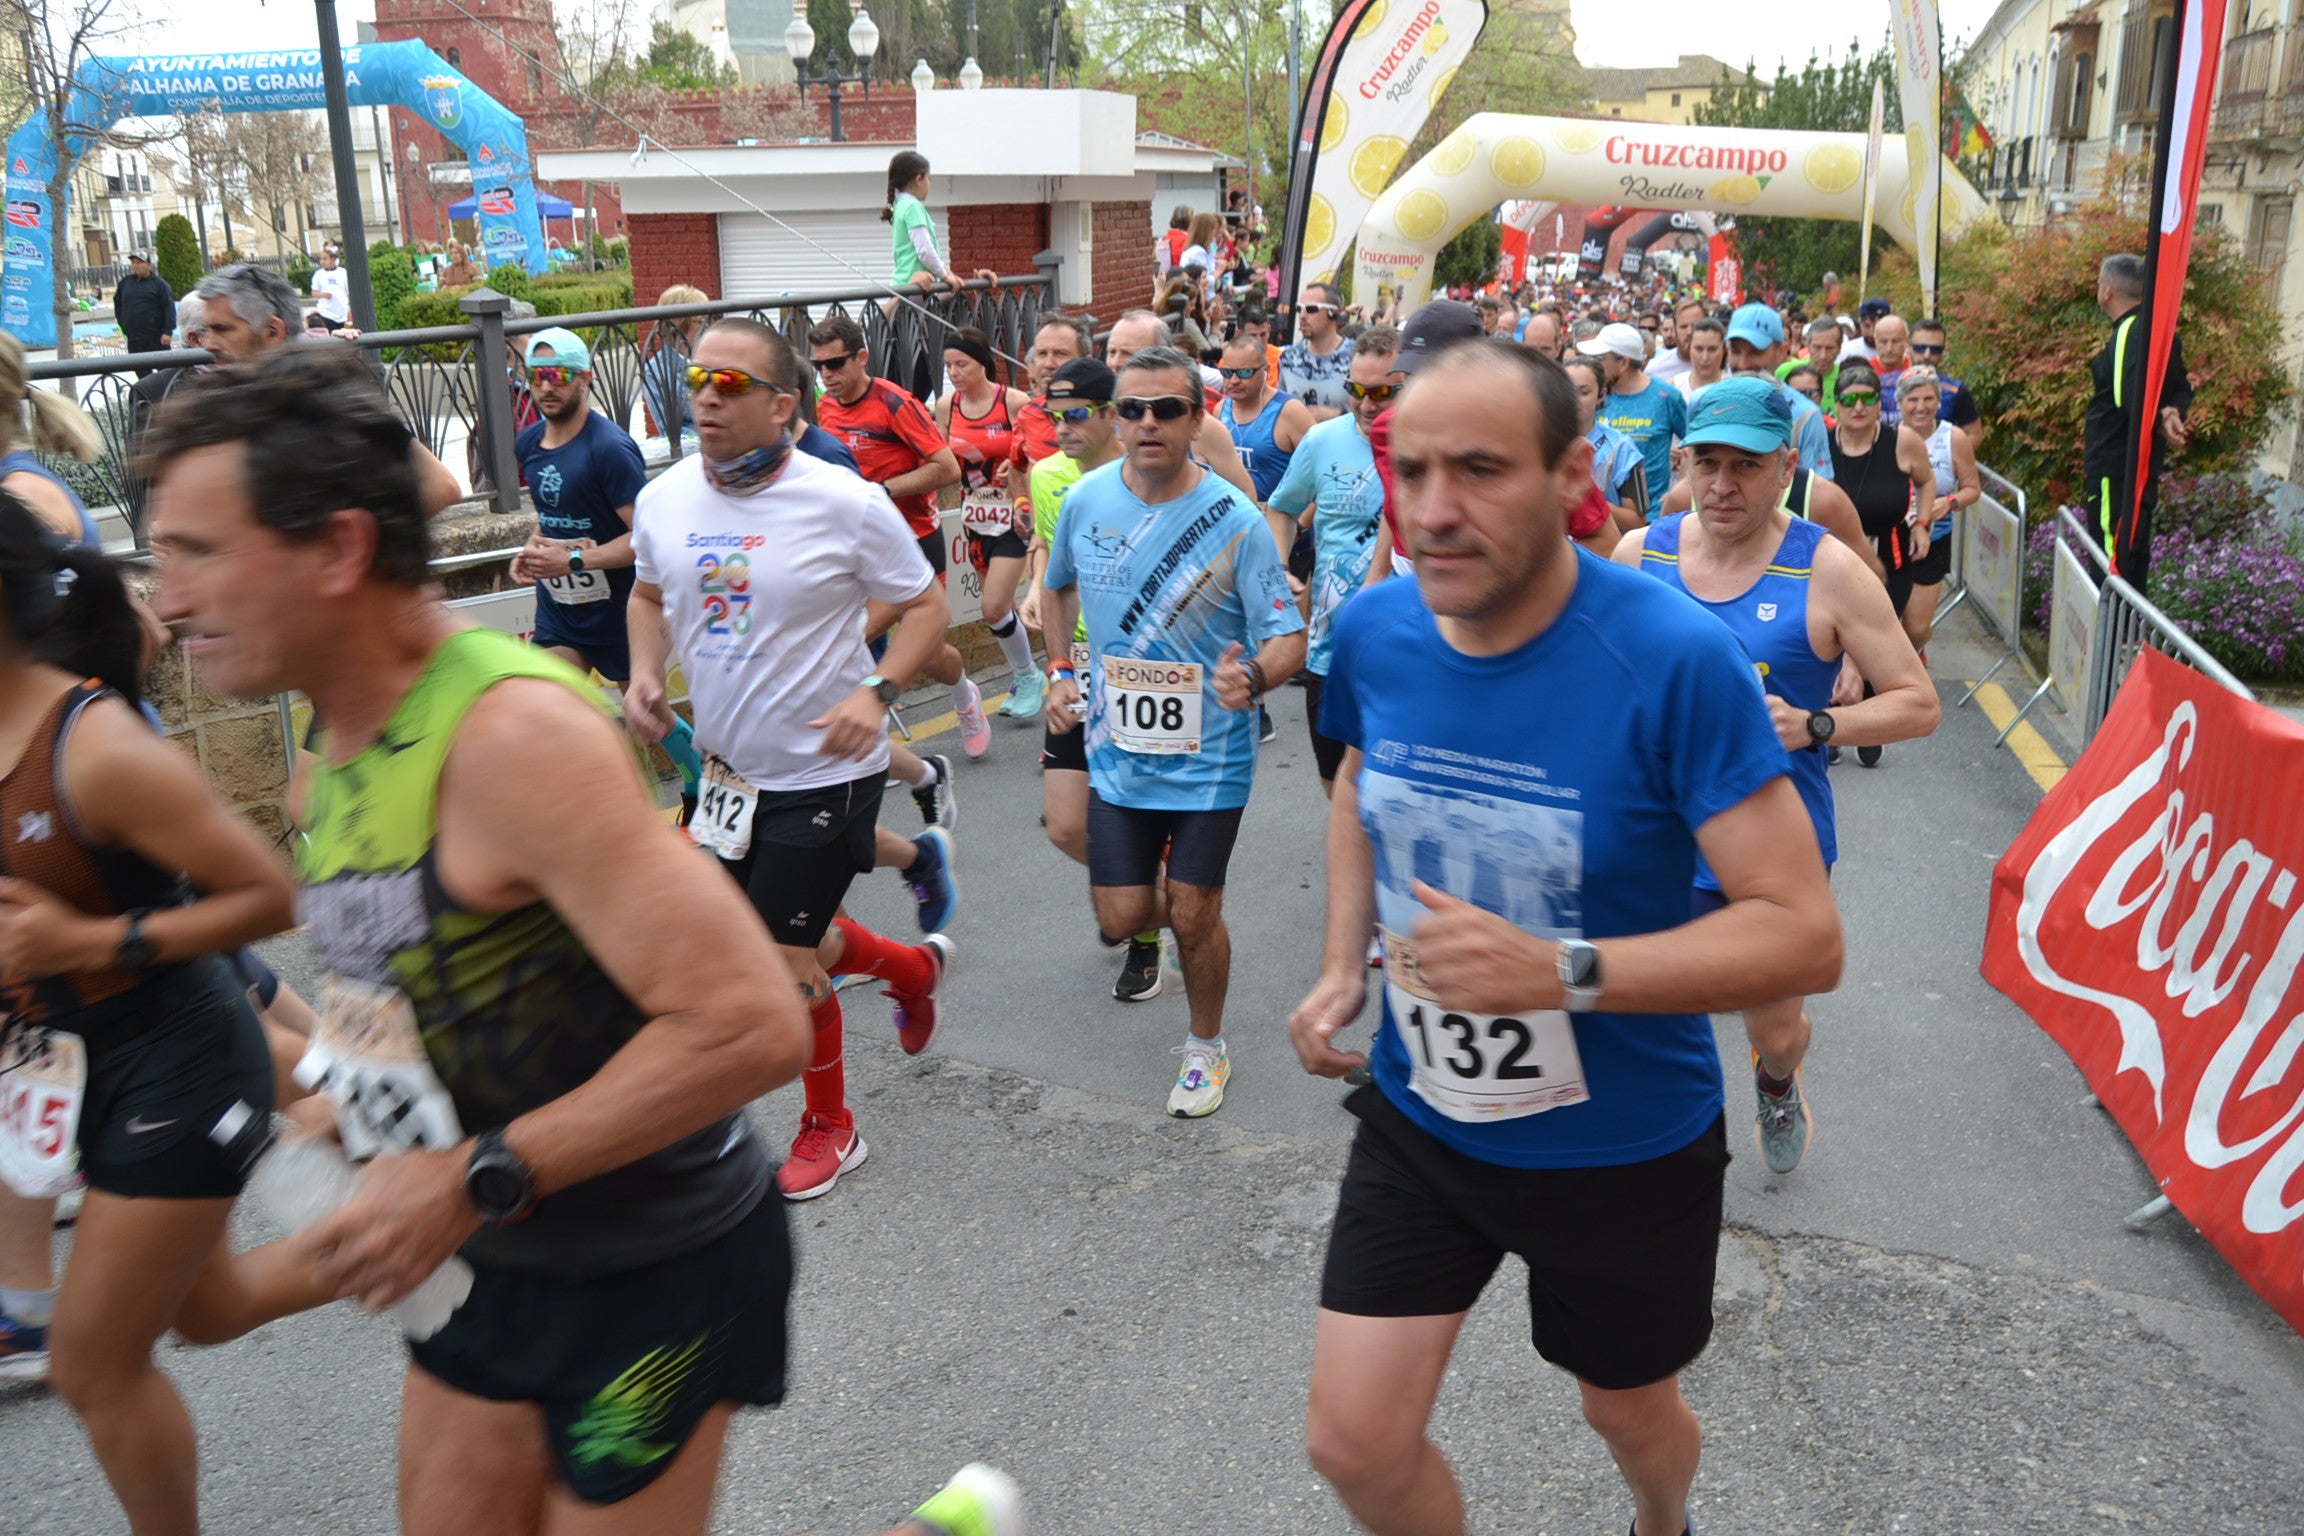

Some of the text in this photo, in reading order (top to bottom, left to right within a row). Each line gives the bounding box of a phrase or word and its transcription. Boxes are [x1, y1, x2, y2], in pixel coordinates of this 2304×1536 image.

[127, 51, 322, 73] AYUNTAMIENTO
[1360, 0, 1440, 100] Cruzcampo
[130, 69, 362, 96] ALHAMA DE GRANAA
[1386, 56, 1429, 102] Radler
[245, 95, 263, 106] DE
[1605, 135, 1787, 176] Cruzcampo
[1620, 173, 1705, 201] Radler
[1360, 248, 1424, 266] Cruzcampo
[964, 505, 1011, 526] 2042
[686, 531, 766, 551] Santiago
[1118, 494, 1237, 637] WWW.CORTIJOPUERTA.COM
[1118, 666, 1180, 685] FONDO
[1117, 693, 1184, 731] 108
[1407, 1003, 1545, 1080] 132
